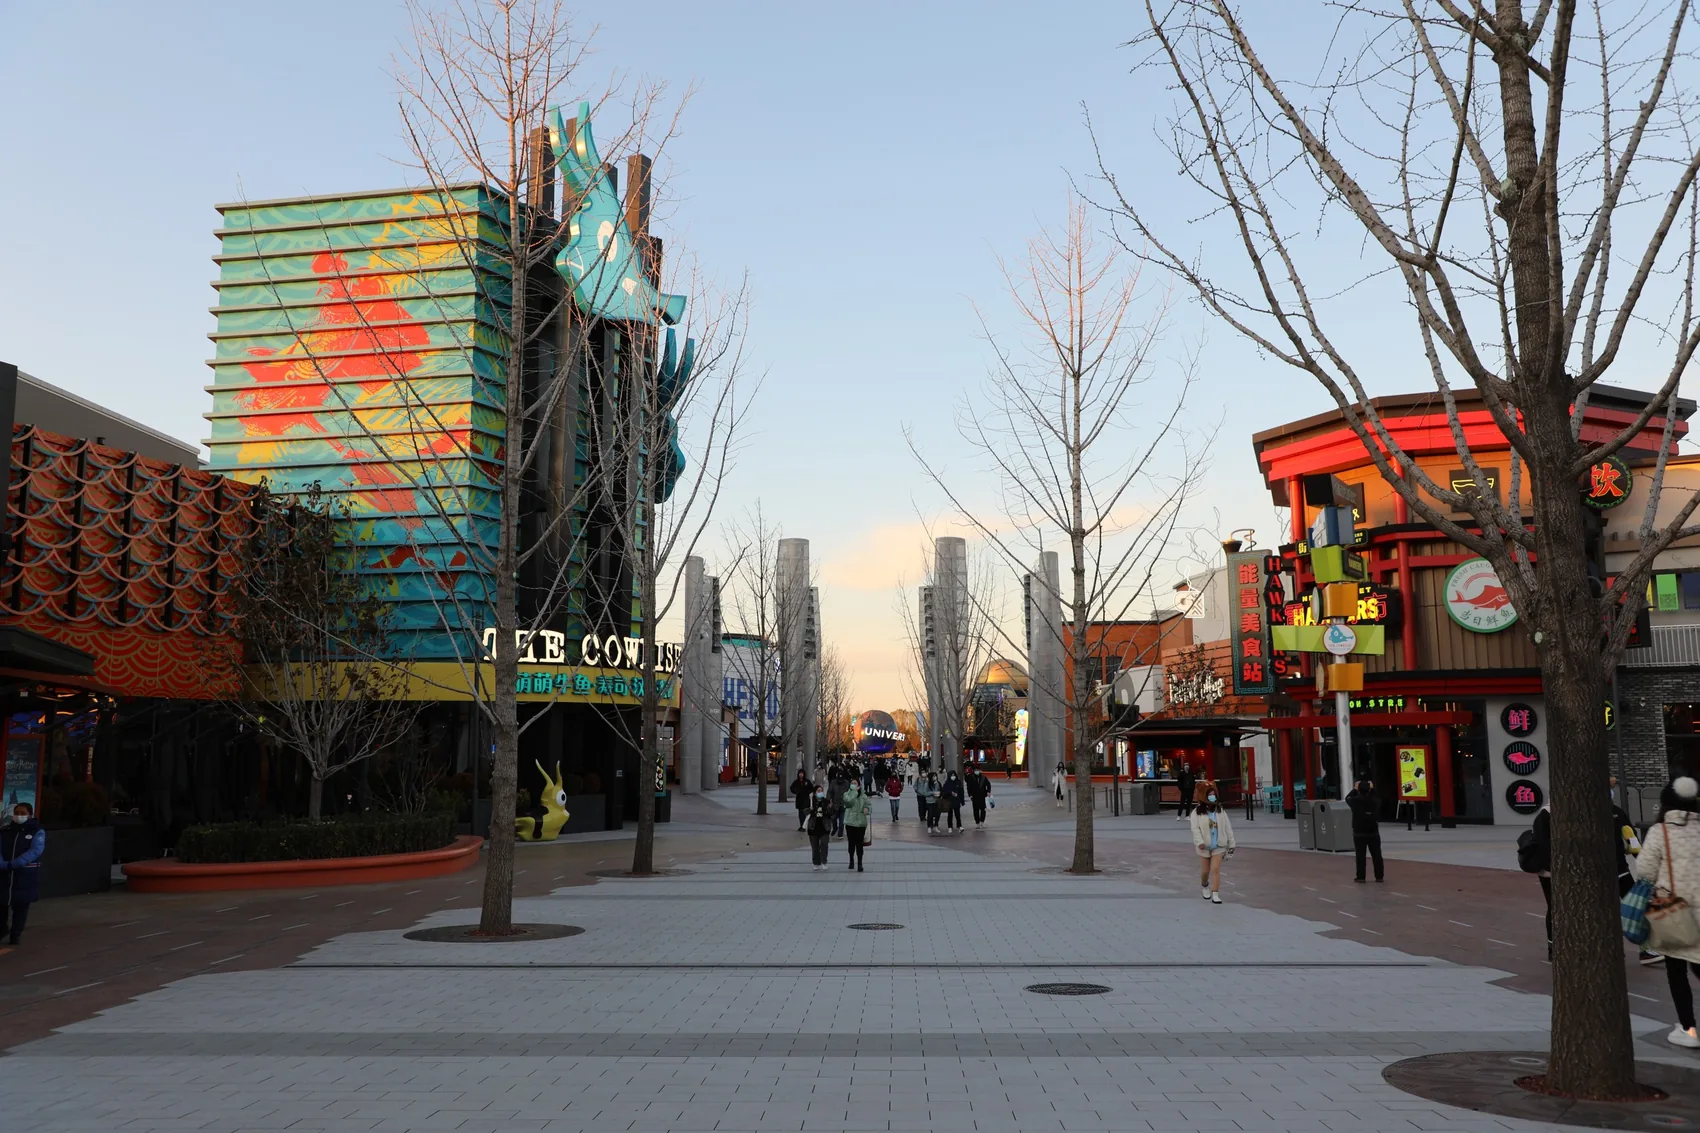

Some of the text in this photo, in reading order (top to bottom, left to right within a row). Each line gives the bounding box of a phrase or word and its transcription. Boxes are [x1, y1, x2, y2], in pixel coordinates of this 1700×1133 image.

[1589, 462, 1624, 498] 饮
[1238, 563, 1263, 683] 能量美食站
[1268, 557, 1287, 674] HAWKS
[1508, 709, 1531, 731] 鲜
[1514, 785, 1537, 807] 鱼
